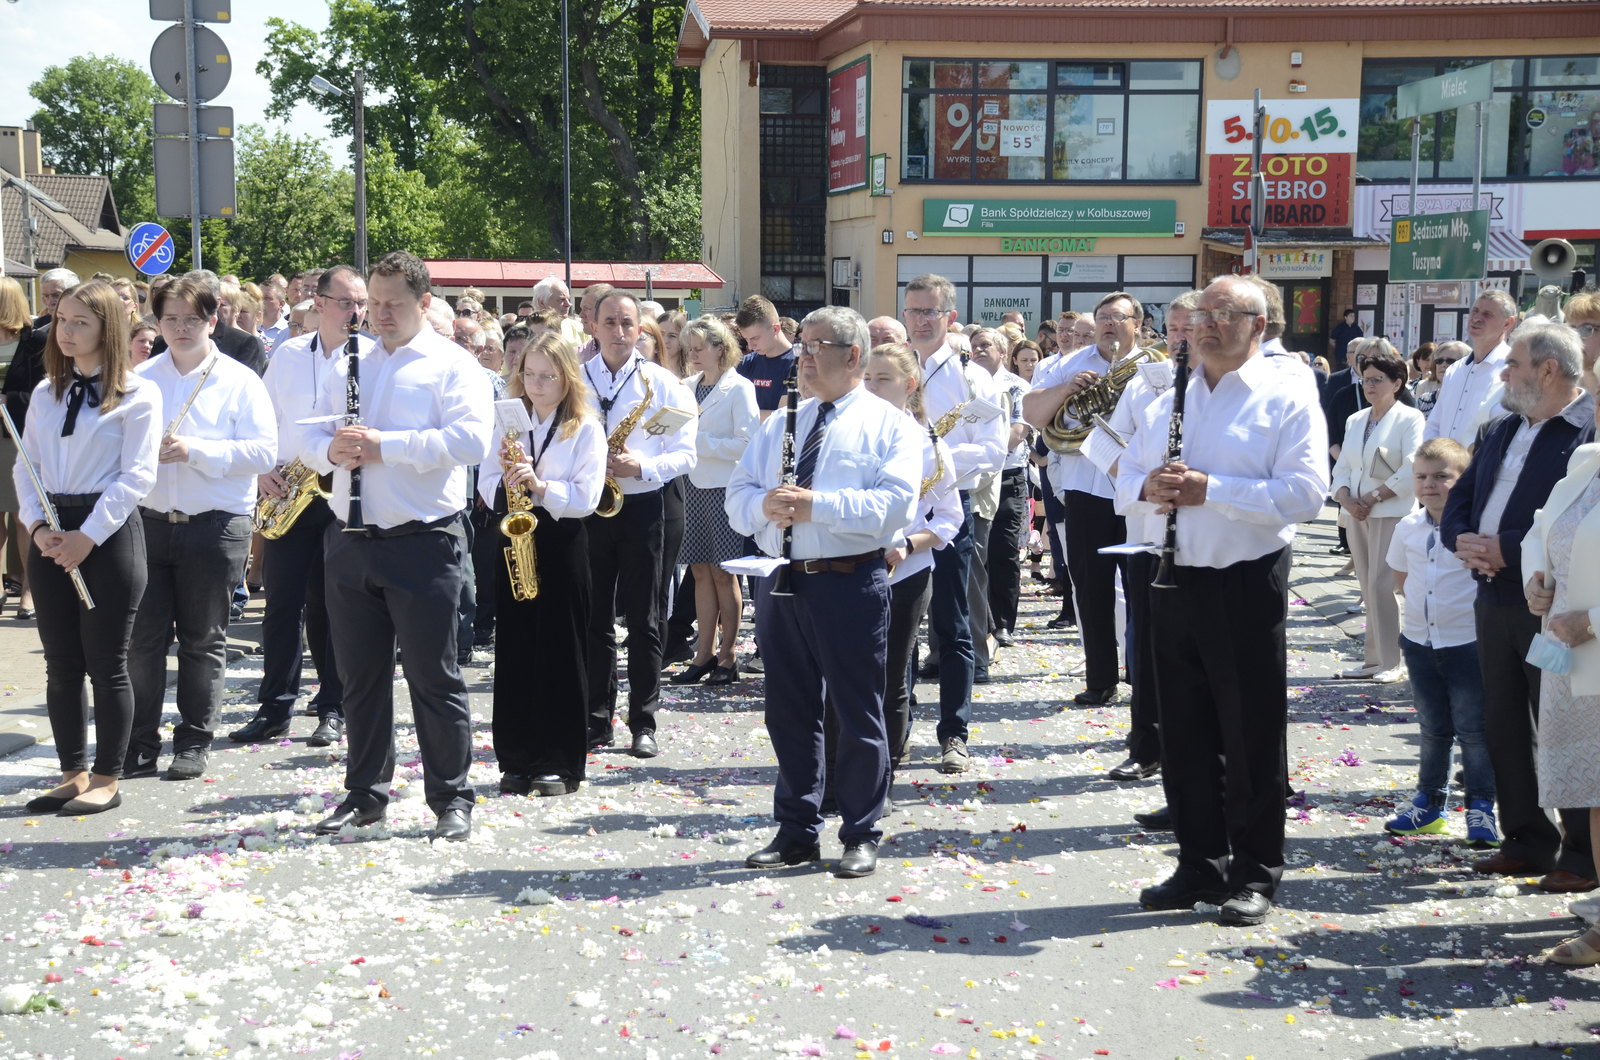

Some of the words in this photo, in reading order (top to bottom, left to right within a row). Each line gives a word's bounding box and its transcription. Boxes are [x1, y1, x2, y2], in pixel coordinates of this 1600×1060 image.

[1441, 77, 1467, 99] Mielec
[1003, 124, 1044, 132] NOWOŚCI
[1232, 180, 1327, 200] SEBRO
[1395, 199, 1442, 210] LOOWA
[1445, 198, 1488, 209] POKUA
[981, 208, 1007, 218] Bank
[1009, 207, 1074, 221] Spółdzielczy
[1076, 210, 1085, 218] w
[1087, 207, 1151, 220] Kolbuszowej
[1412, 219, 1449, 245] Sędziszów
[1450, 217, 1471, 243] Młp.
[1001, 238, 1098, 253] BANKOMAT
[1412, 252, 1441, 276] Tuszyma
[984, 298, 1031, 308] BANKOMAT
[981, 311, 1033, 321] WPŁAAT
